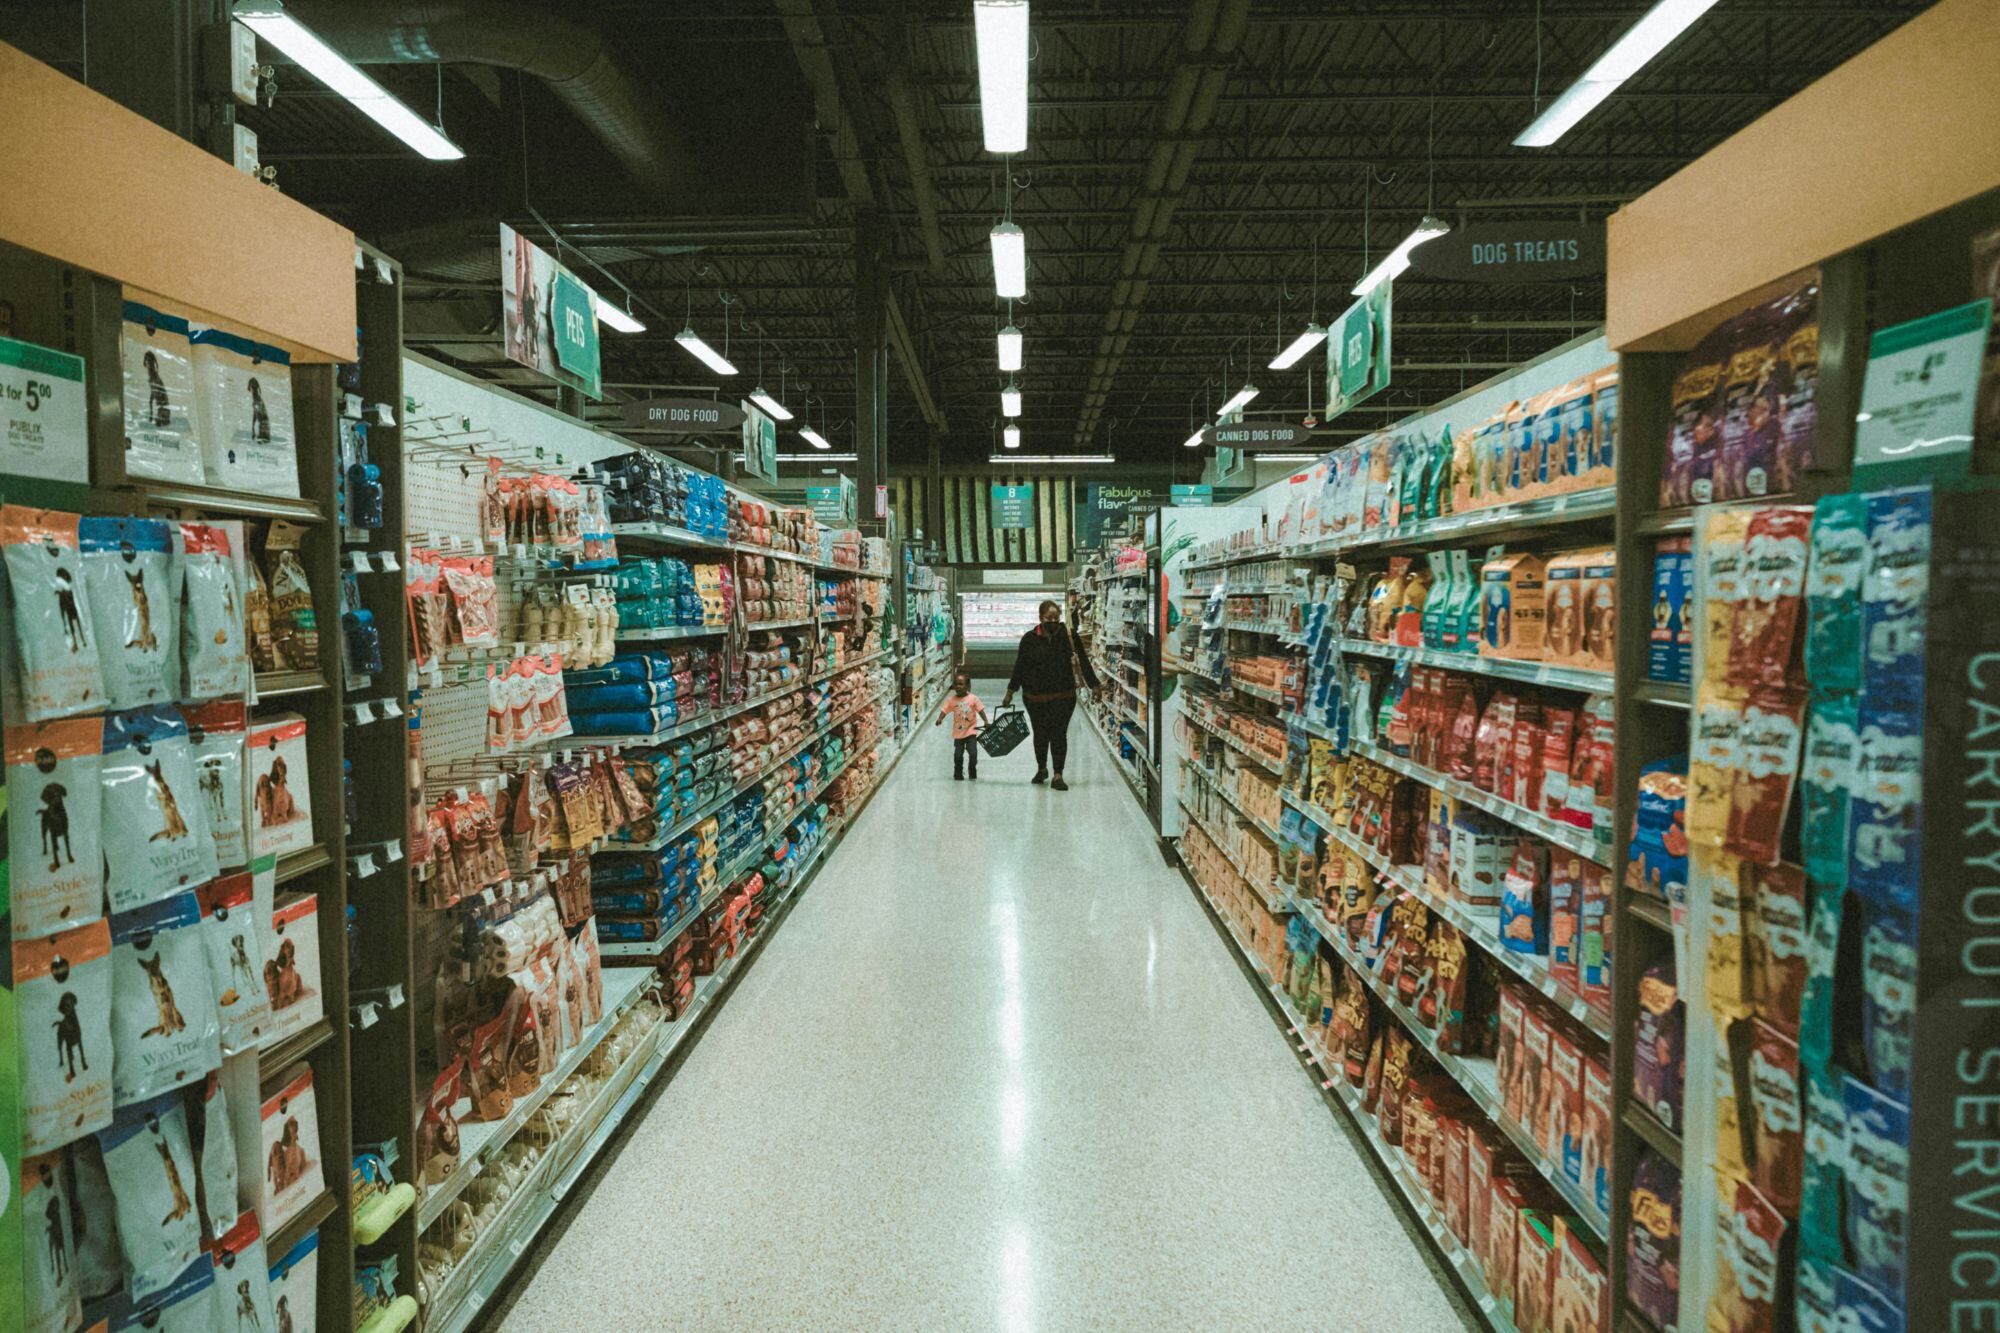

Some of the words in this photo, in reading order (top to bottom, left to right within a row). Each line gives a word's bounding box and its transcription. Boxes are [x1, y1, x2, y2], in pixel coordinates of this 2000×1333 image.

[1472, 242, 1507, 265] DOG
[1513, 239, 1579, 264] TREATS
[565, 305, 585, 349] PETS
[7, 384, 23, 401] for
[649, 407, 668, 421] DRY
[670, 408, 690, 421] DOG
[693, 409, 719, 422] FOOD
[9, 419, 42, 434] PUBLIX
[1216, 430, 1250, 442] CANNED
[1252, 430, 1269, 441] DOG
[1271, 429, 1294, 440] FOOD
[1008, 487, 1016, 498] 8
[1098, 485, 1153, 498] Fabulous
[1188, 486, 1195, 496] 7
[1949, 1048, 2000, 1333] SERVICE
